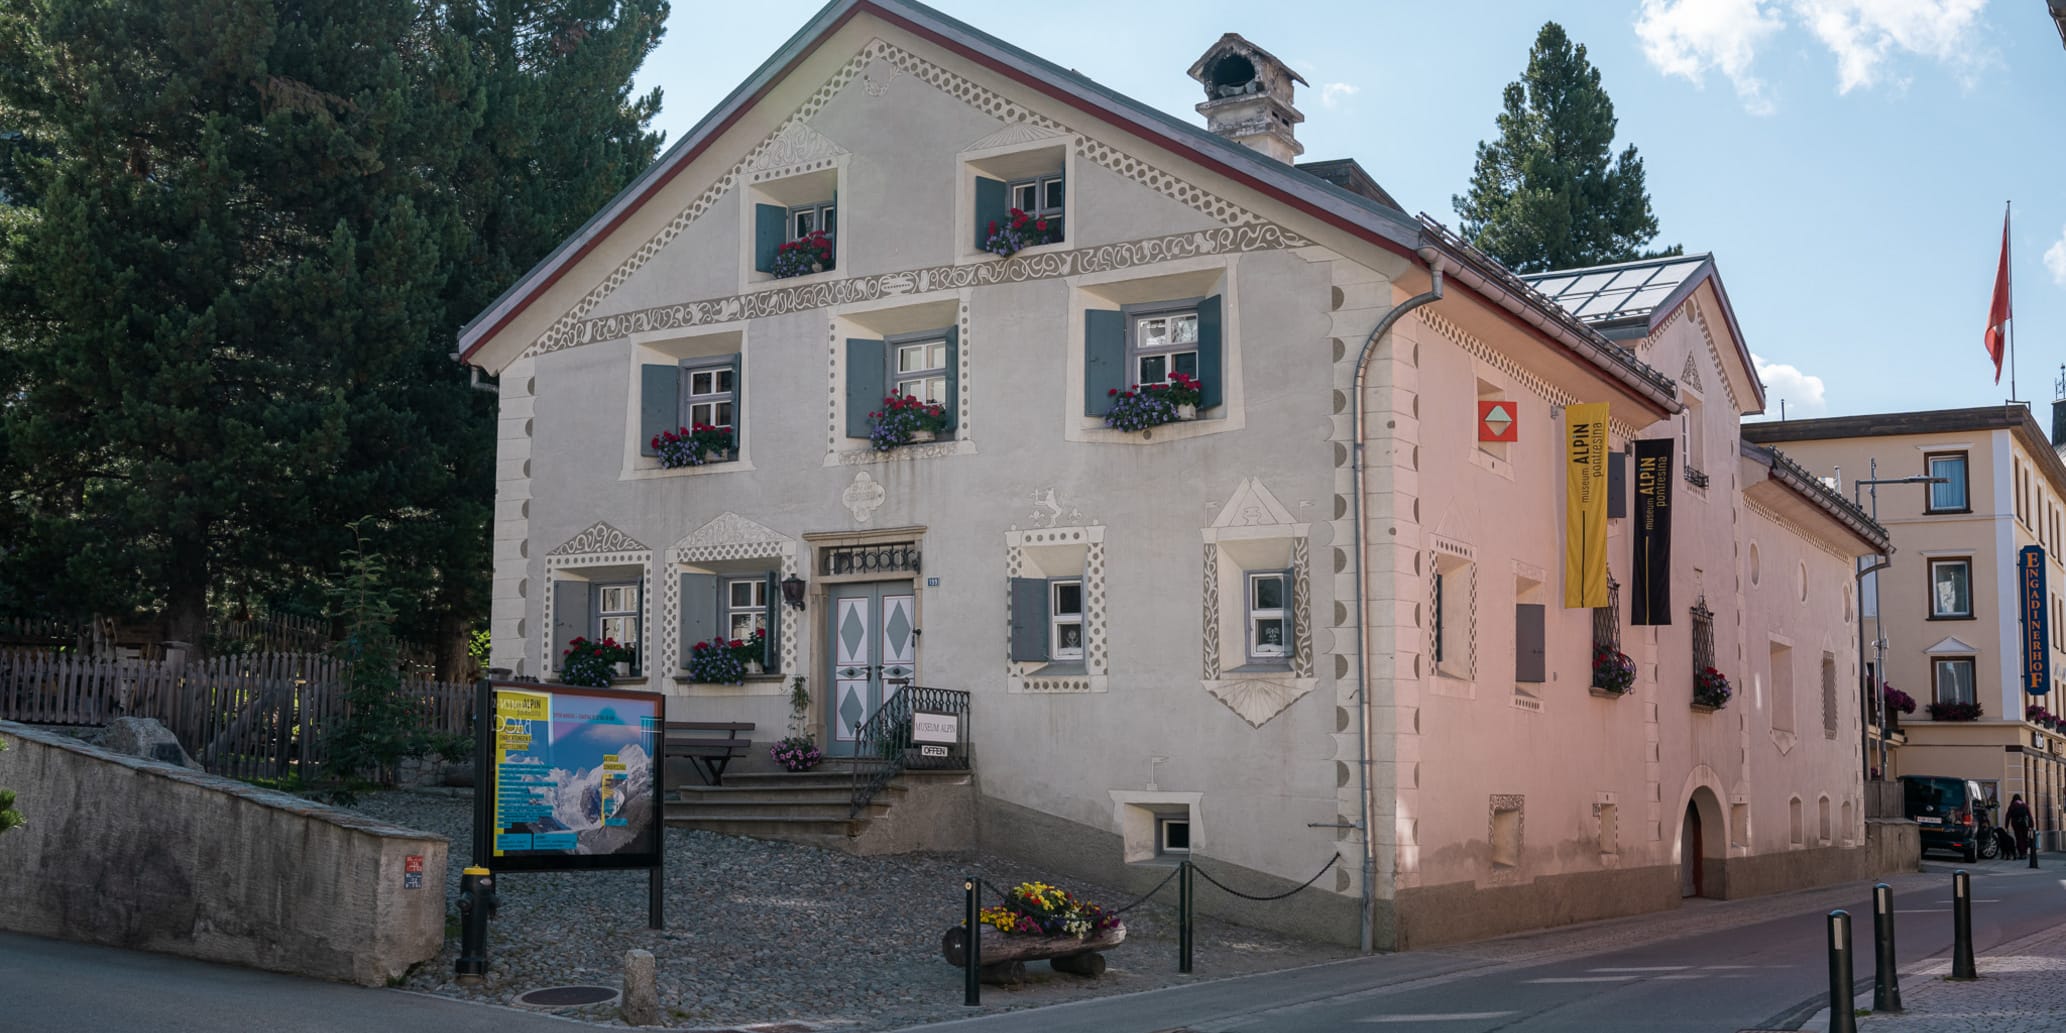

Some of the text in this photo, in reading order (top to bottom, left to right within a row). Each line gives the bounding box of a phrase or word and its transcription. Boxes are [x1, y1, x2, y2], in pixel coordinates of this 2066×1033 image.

[1593, 422, 1604, 477] pontresina
[1656, 456, 1667, 506] pontresina
[1646, 498, 1654, 530] museum
[2025, 552, 2043, 688] ENGADINERHOF
[916, 722, 939, 731] MUSEUM
[924, 746, 946, 755] OFFEN
